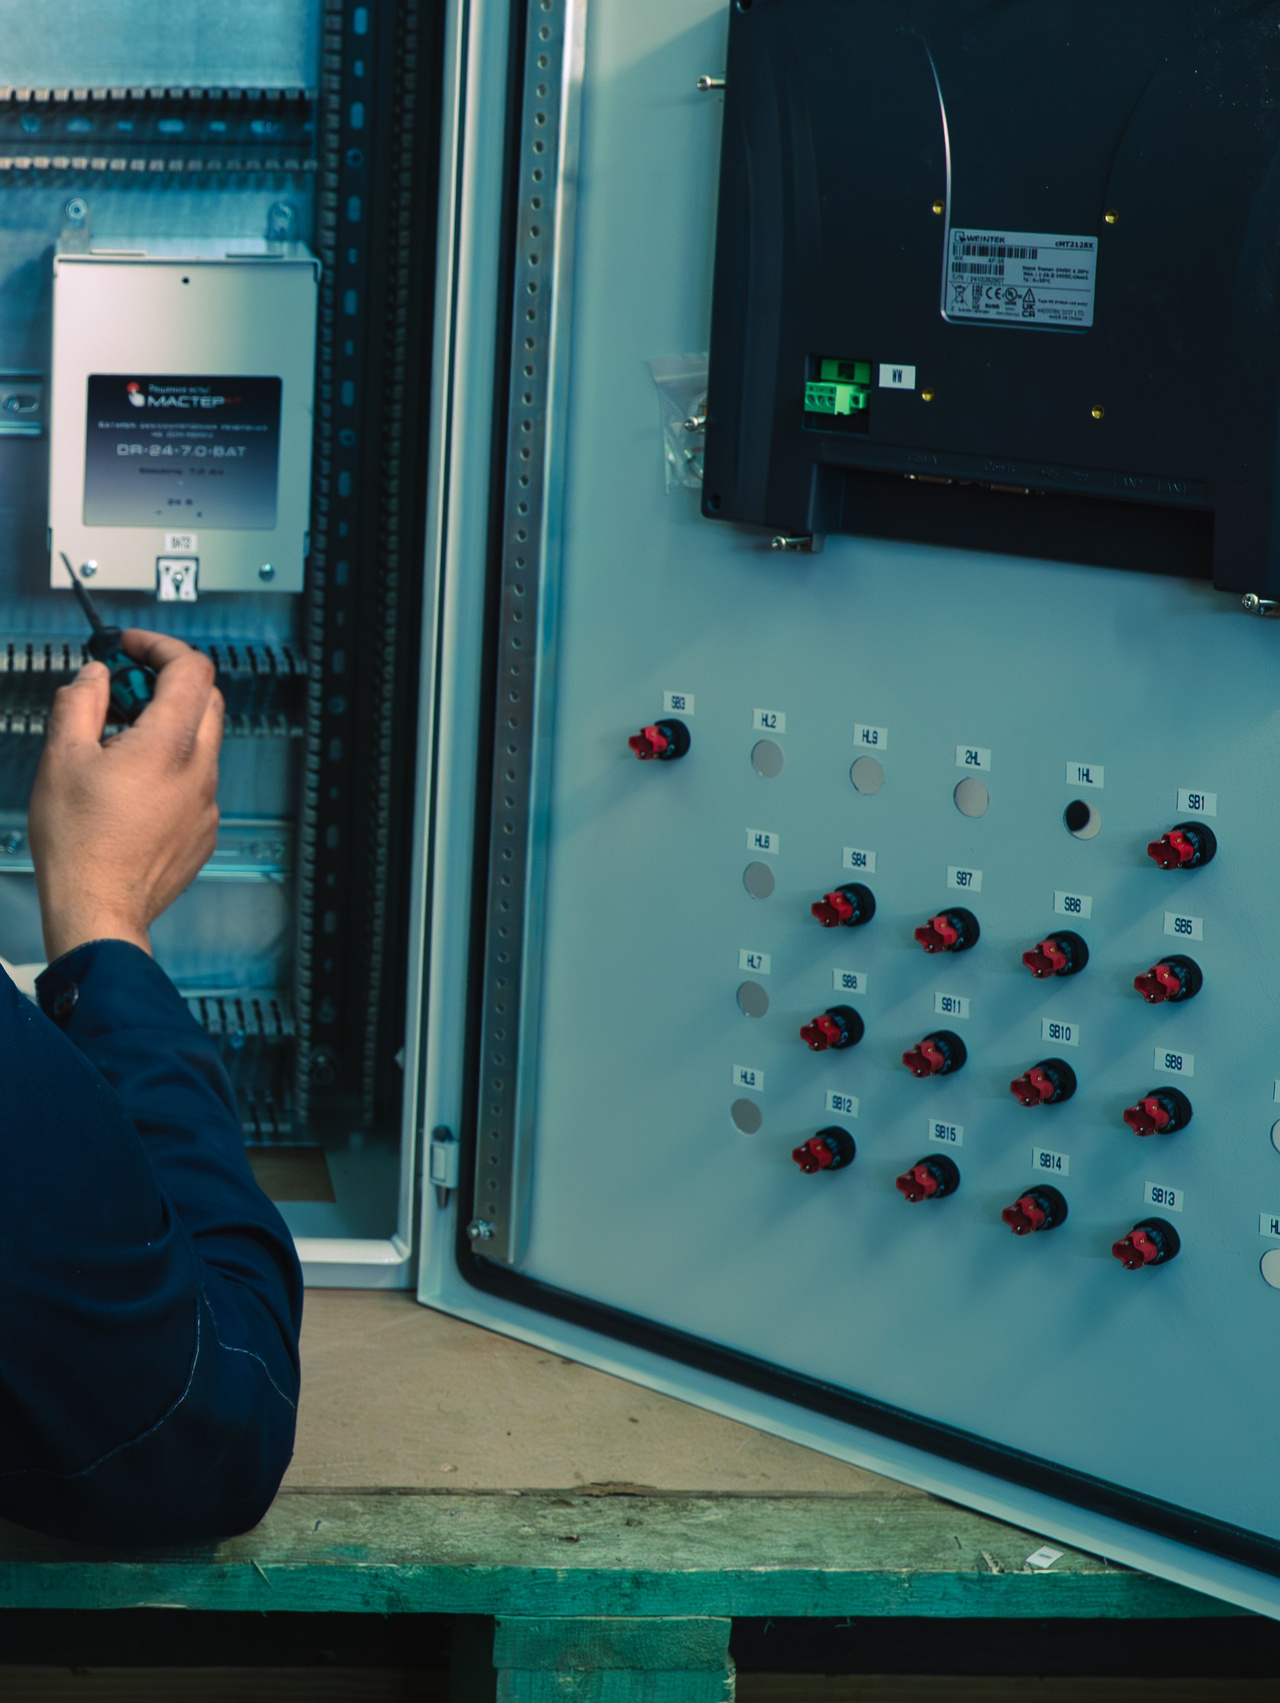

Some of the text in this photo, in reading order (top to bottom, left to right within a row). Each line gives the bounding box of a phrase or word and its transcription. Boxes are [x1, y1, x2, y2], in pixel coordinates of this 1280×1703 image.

[761, 713, 777, 729] HL2
[964, 749, 982, 767] 2HL
[1077, 767, 1094, 784] 1HL
[1188, 793, 1206, 811] SB1
[851, 851, 867, 867] SB4
[956, 870, 973, 887] SB7
[1064, 896, 1082, 914] SB6
[1174, 917, 1193, 935] SB5
[747, 953, 763, 970] HL7
[941, 996, 962, 1013] SB11
[1050, 1023, 1072, 1041] SB10
[1164, 1053, 1183, 1071] SB9
[832, 1094, 853, 1113] SB12
[1039, 1152, 1063, 1171] SB14
[1151, 1186, 1176, 1207] SB13
